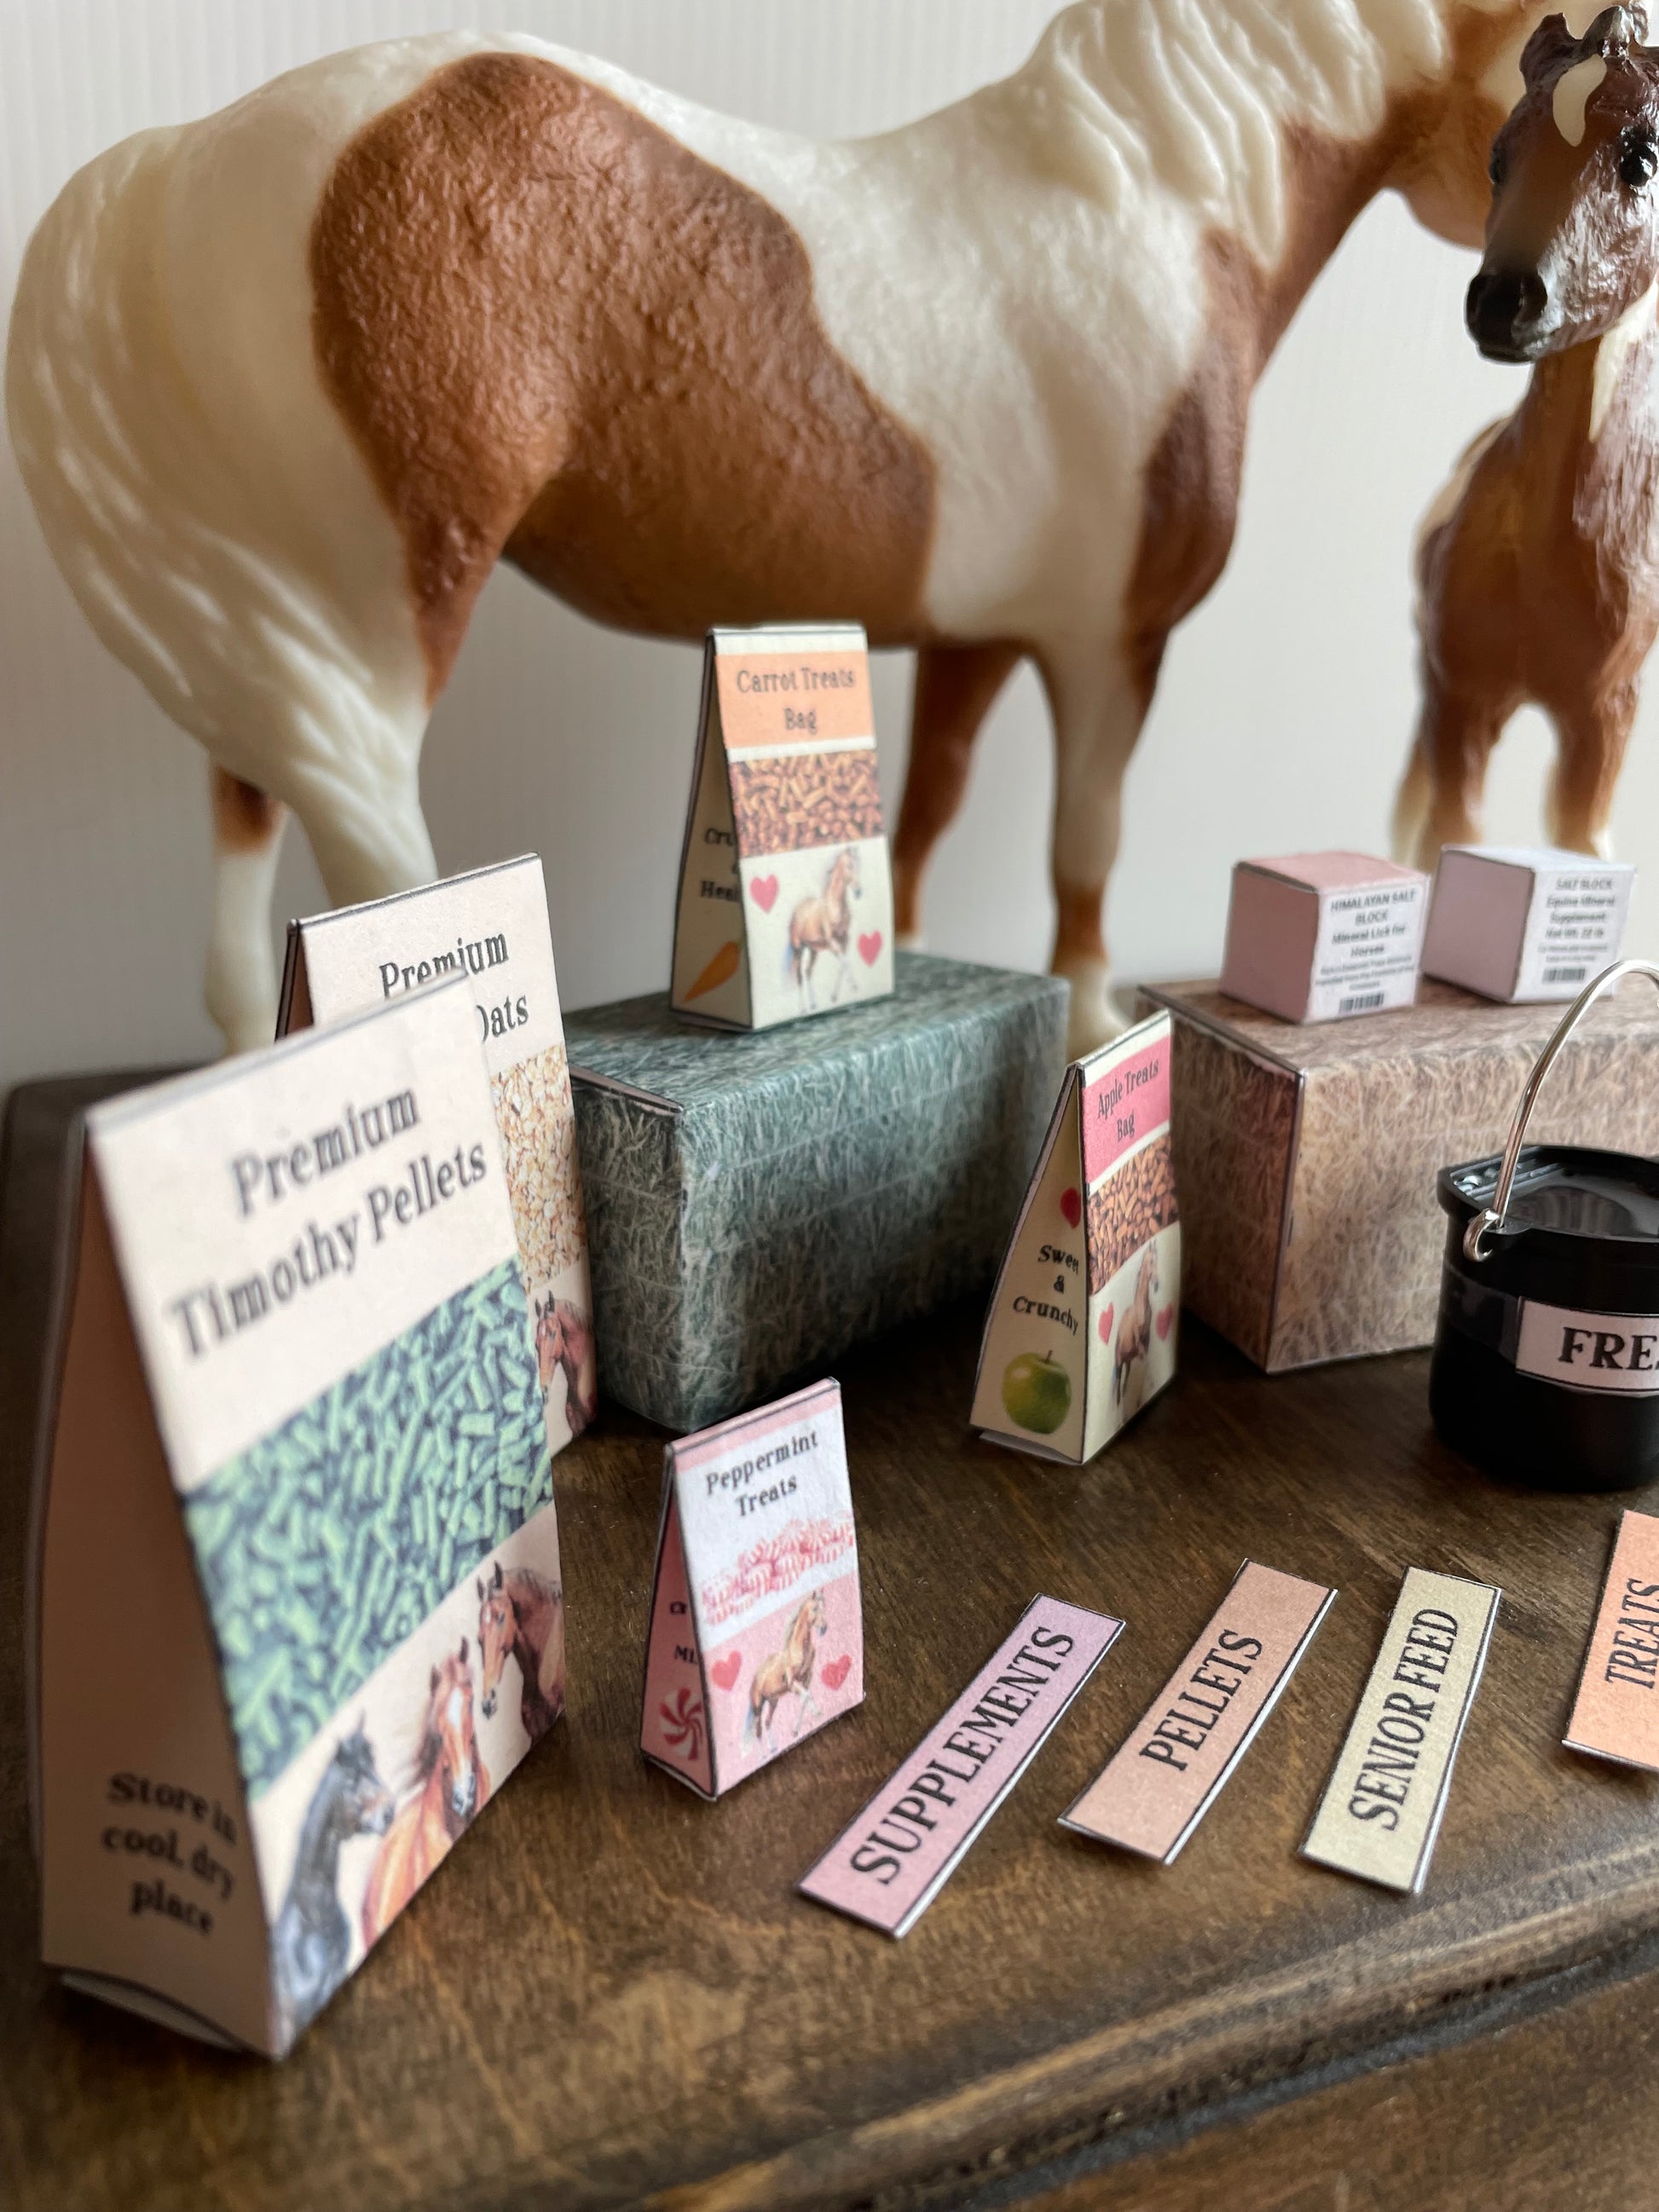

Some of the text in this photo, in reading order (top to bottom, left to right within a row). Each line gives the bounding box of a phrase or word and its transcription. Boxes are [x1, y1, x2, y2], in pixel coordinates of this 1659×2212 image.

[737, 667, 855, 693] Carrot Treats
[784, 707, 818, 735] Bag
[1331, 888, 1415, 912] HIMALAYAN SALT
[1555, 877, 1612, 890] SALT BLOCK
[1356, 909, 1389, 925] BLOCK
[379, 933, 509, 997] Premium
[1098, 1060, 1159, 1119] Apple Treats
[1117, 1109, 1136, 1141] Bag
[231, 1090, 421, 1219] Premium
[167, 1142, 487, 1357] Timothy Pellets
[1054, 1274, 1065, 1294] &
[1013, 1296, 1078, 1336] Crunchy
[1558, 1326, 1659, 1371] FRE
[706, 1431, 818, 1495] Peppermint
[735, 1475, 798, 1516] Treats
[1139, 1629, 1263, 1771] PELLETS
[1348, 1608, 1459, 1832] SENIOR FEED
[851, 1626, 1075, 1886] SUPPLEMENTS
[107, 1771, 237, 1845] Store in
[191, 1841, 234, 1902] dry
[129, 1879, 213, 1936] place
